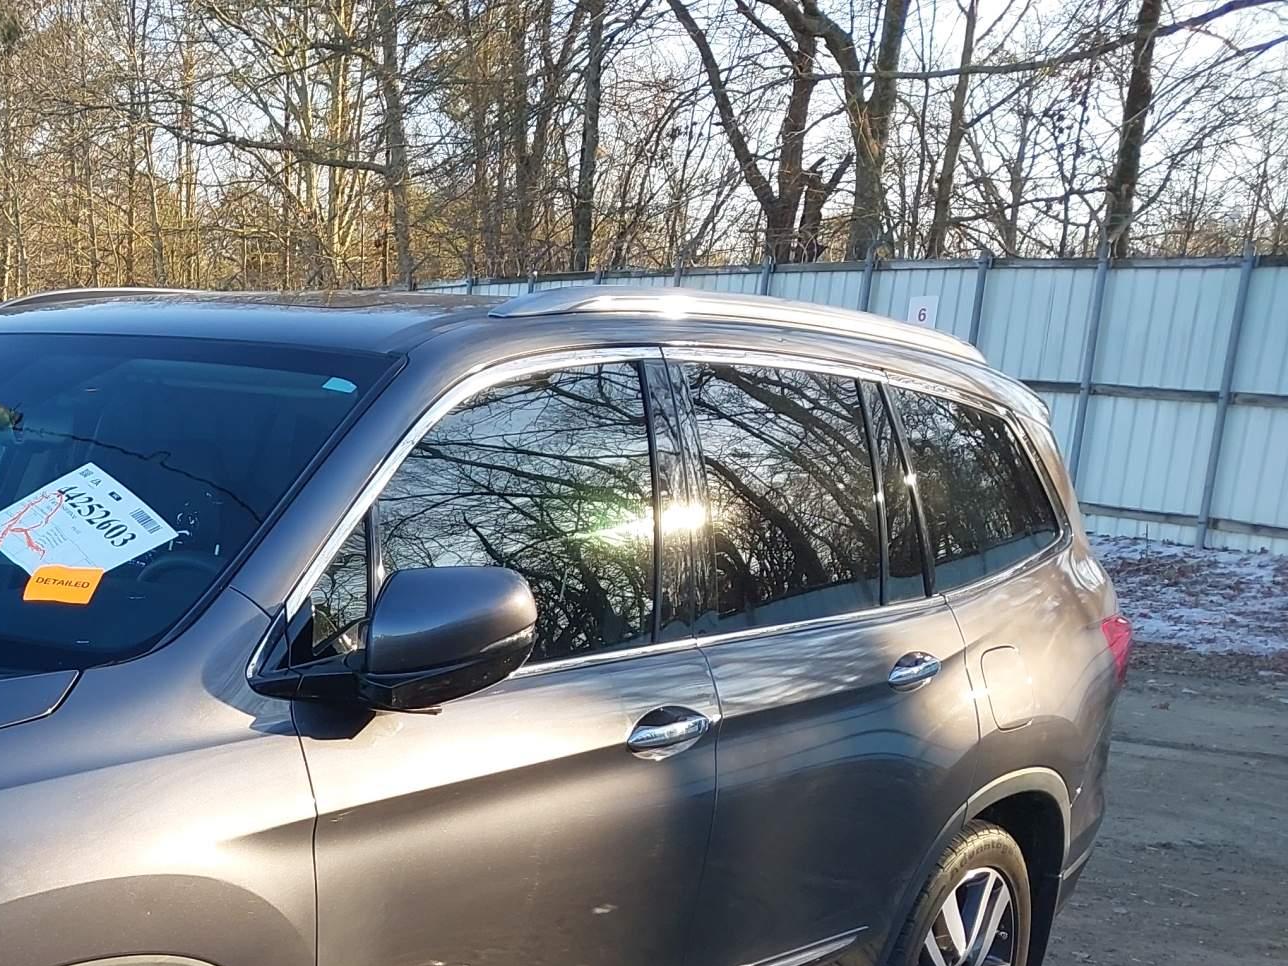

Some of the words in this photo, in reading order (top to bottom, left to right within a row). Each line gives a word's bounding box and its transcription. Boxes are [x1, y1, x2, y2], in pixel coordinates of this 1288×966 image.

[918, 308, 927, 322] 6
[57, 486, 137, 548] 44252603
[35, 576, 91, 590] DETAILED
